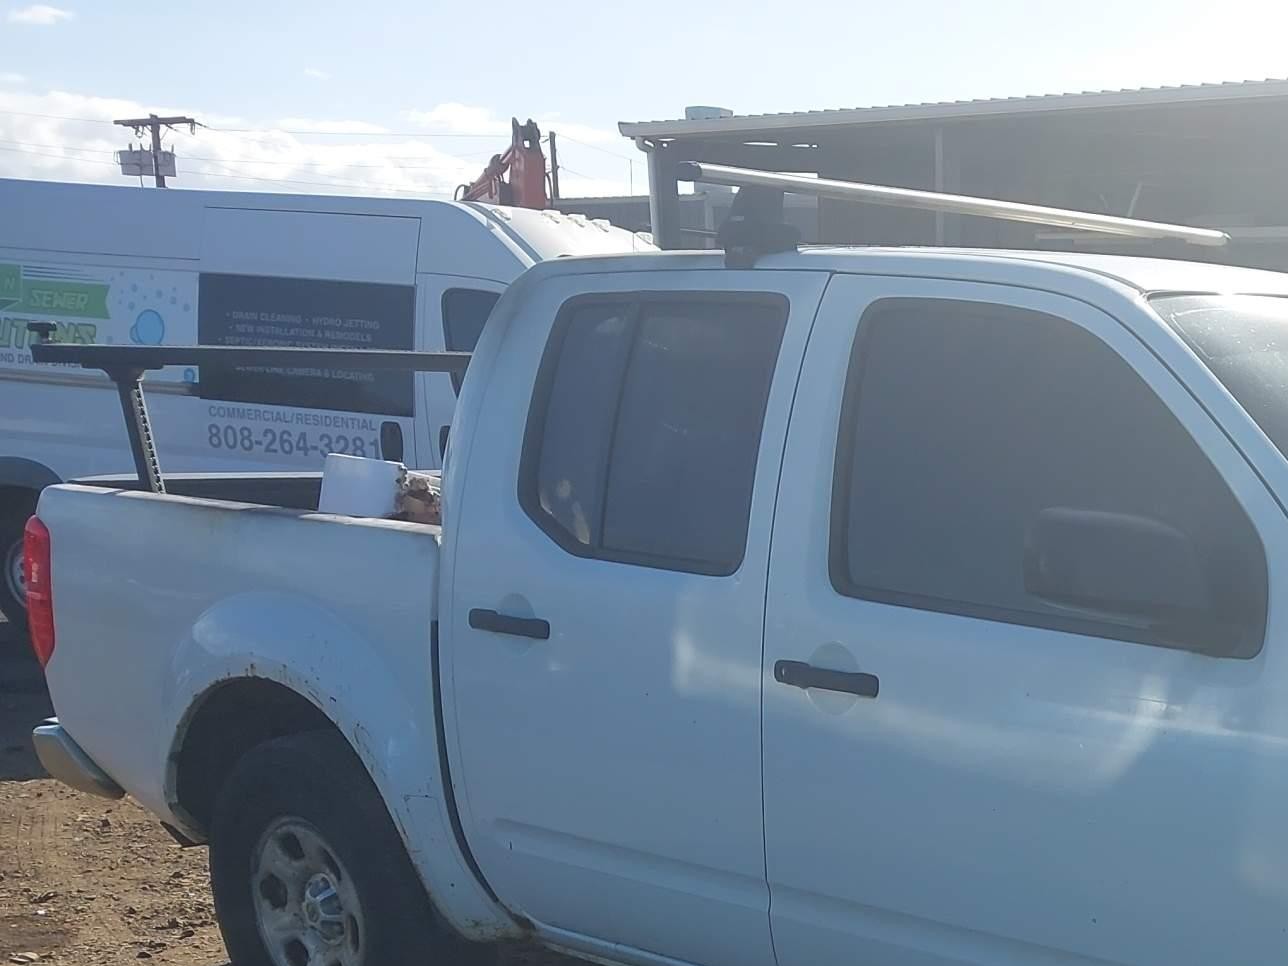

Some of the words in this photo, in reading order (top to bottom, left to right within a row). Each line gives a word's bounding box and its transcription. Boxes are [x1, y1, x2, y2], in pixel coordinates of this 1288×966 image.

[30, 289, 89, 311] SEWER
[260, 312, 302, 323] CLEANING
[343, 319, 380, 329] JETTING
[208, 405, 377, 432] COMMERCIAL/RESIDENTIAL
[207, 423, 379, 460] 808-264-3281
